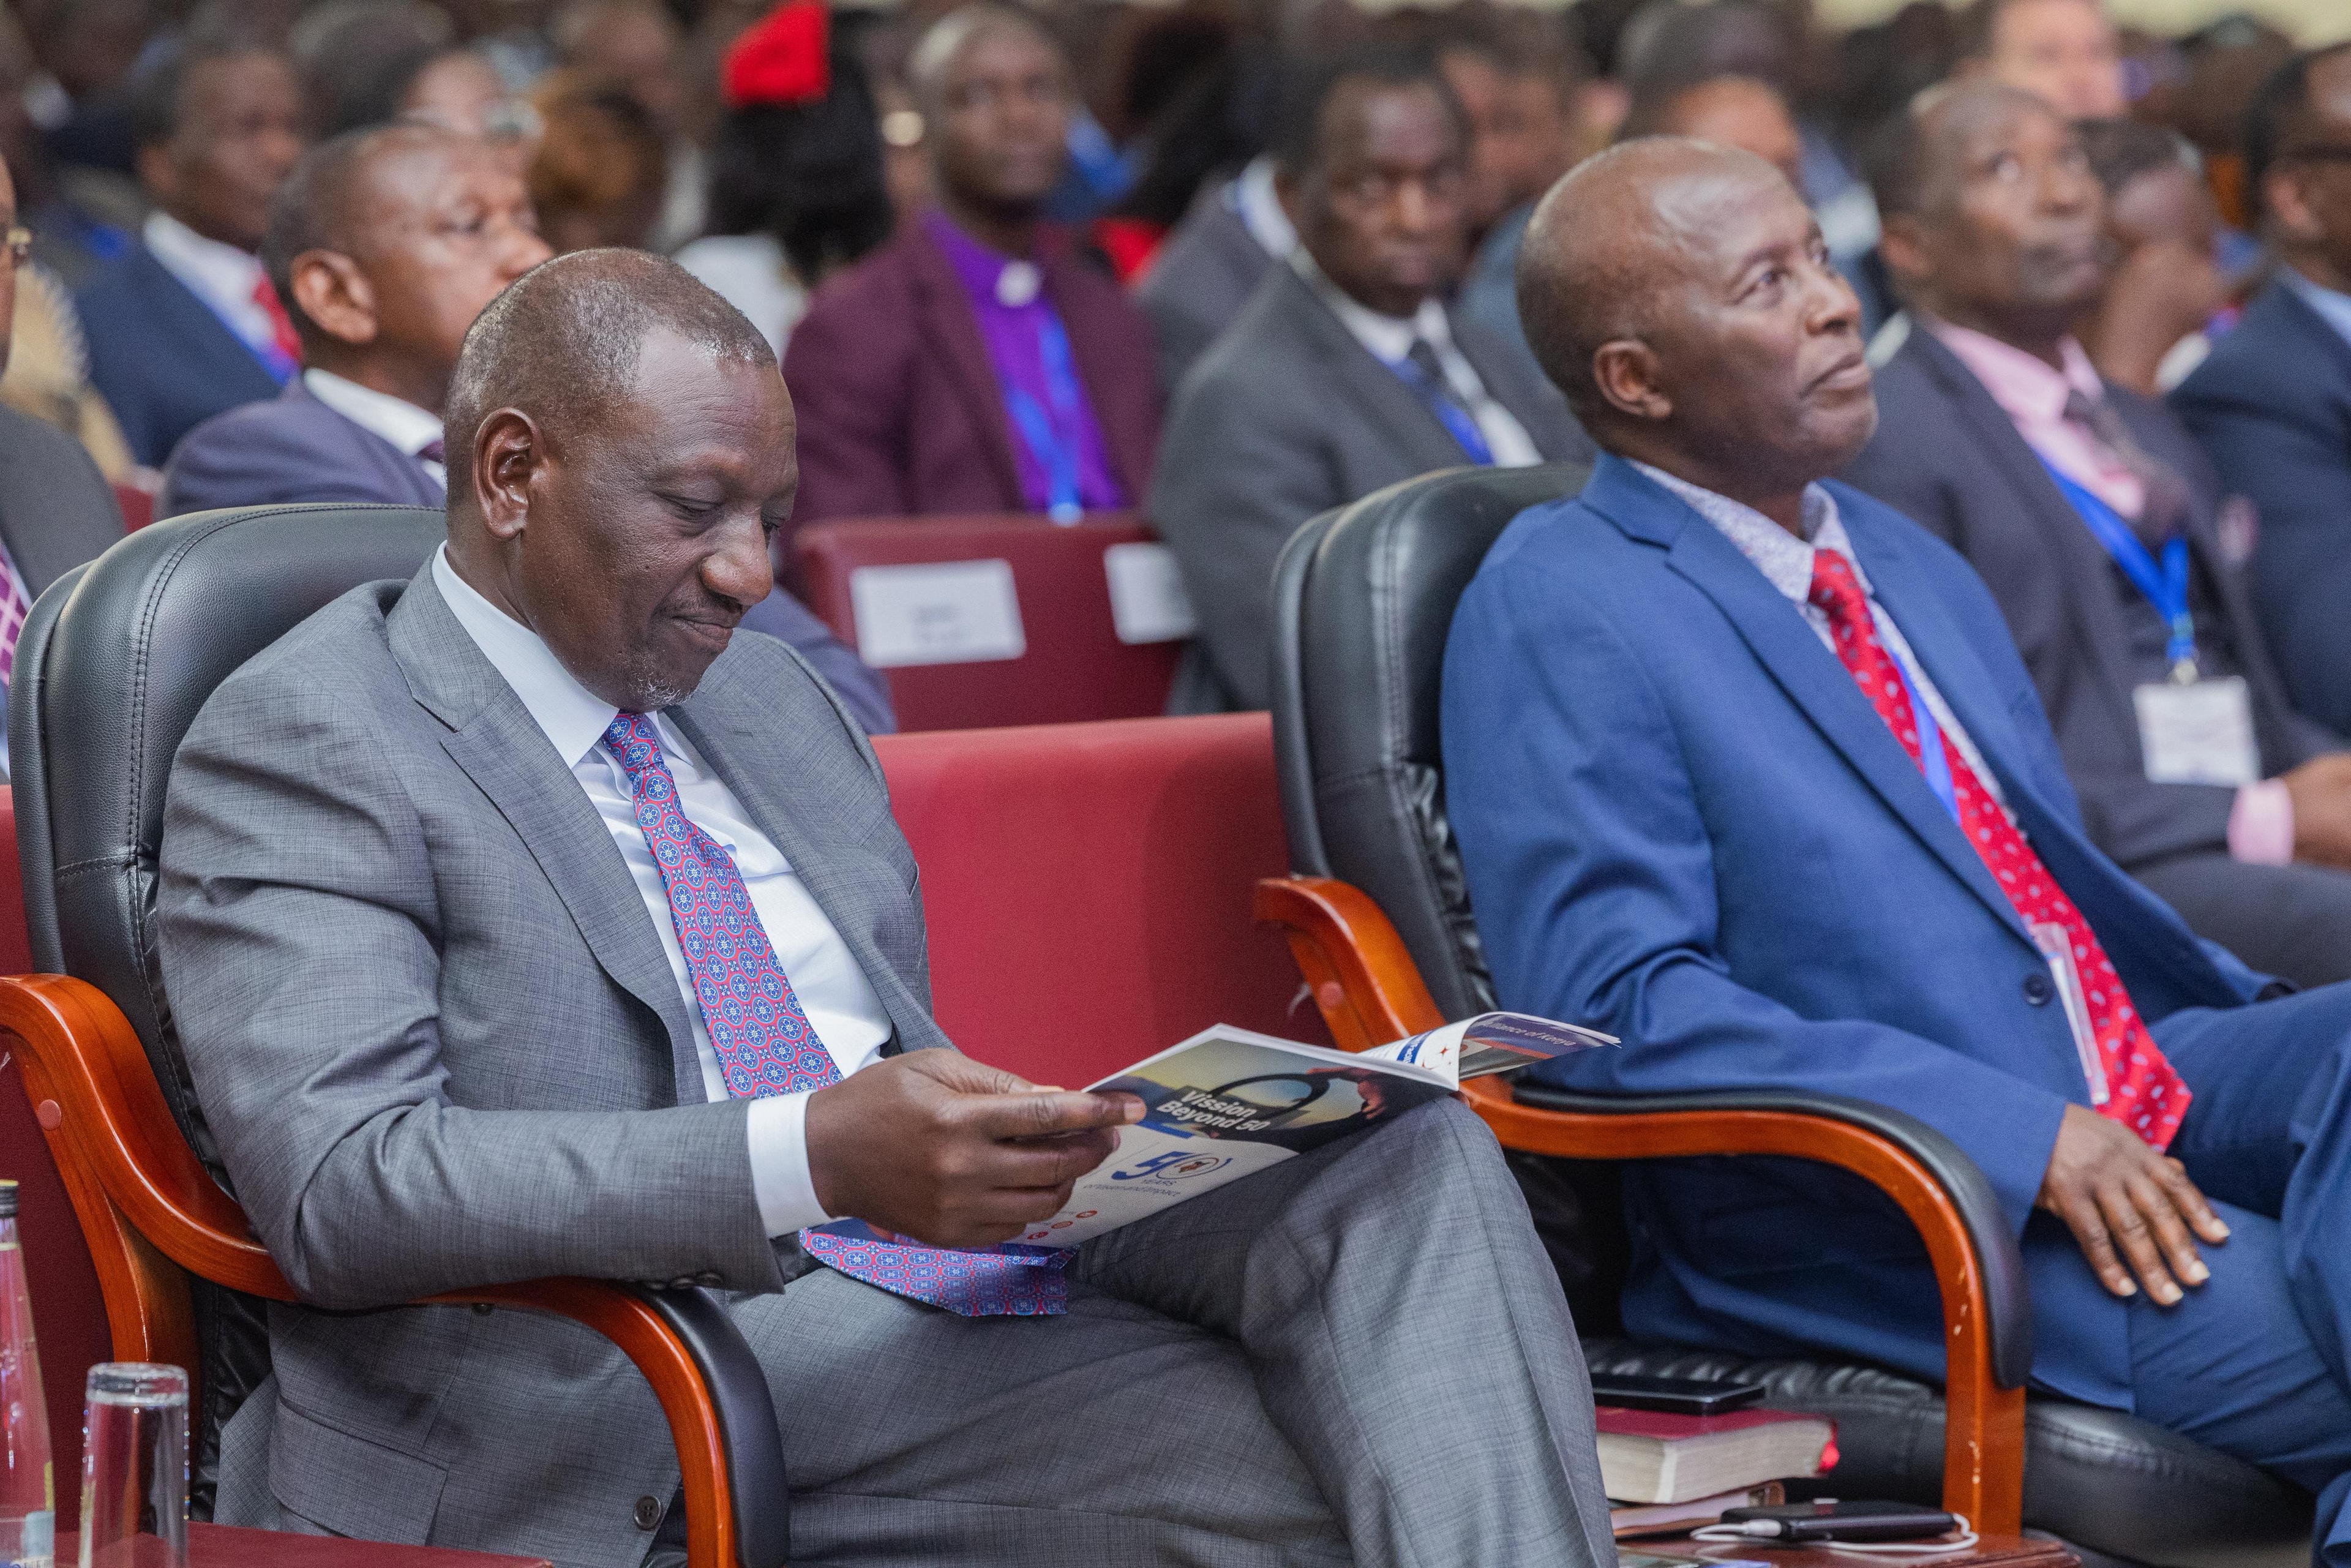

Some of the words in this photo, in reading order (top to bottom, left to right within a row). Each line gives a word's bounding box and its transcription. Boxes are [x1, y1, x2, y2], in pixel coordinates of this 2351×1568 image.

[1537, 1033, 1577, 1046] Kenya
[1156, 1100, 1245, 1128] Beyond
[1235, 1120, 1271, 1131] 50
[1181, 1090, 1257, 1118] Vission
